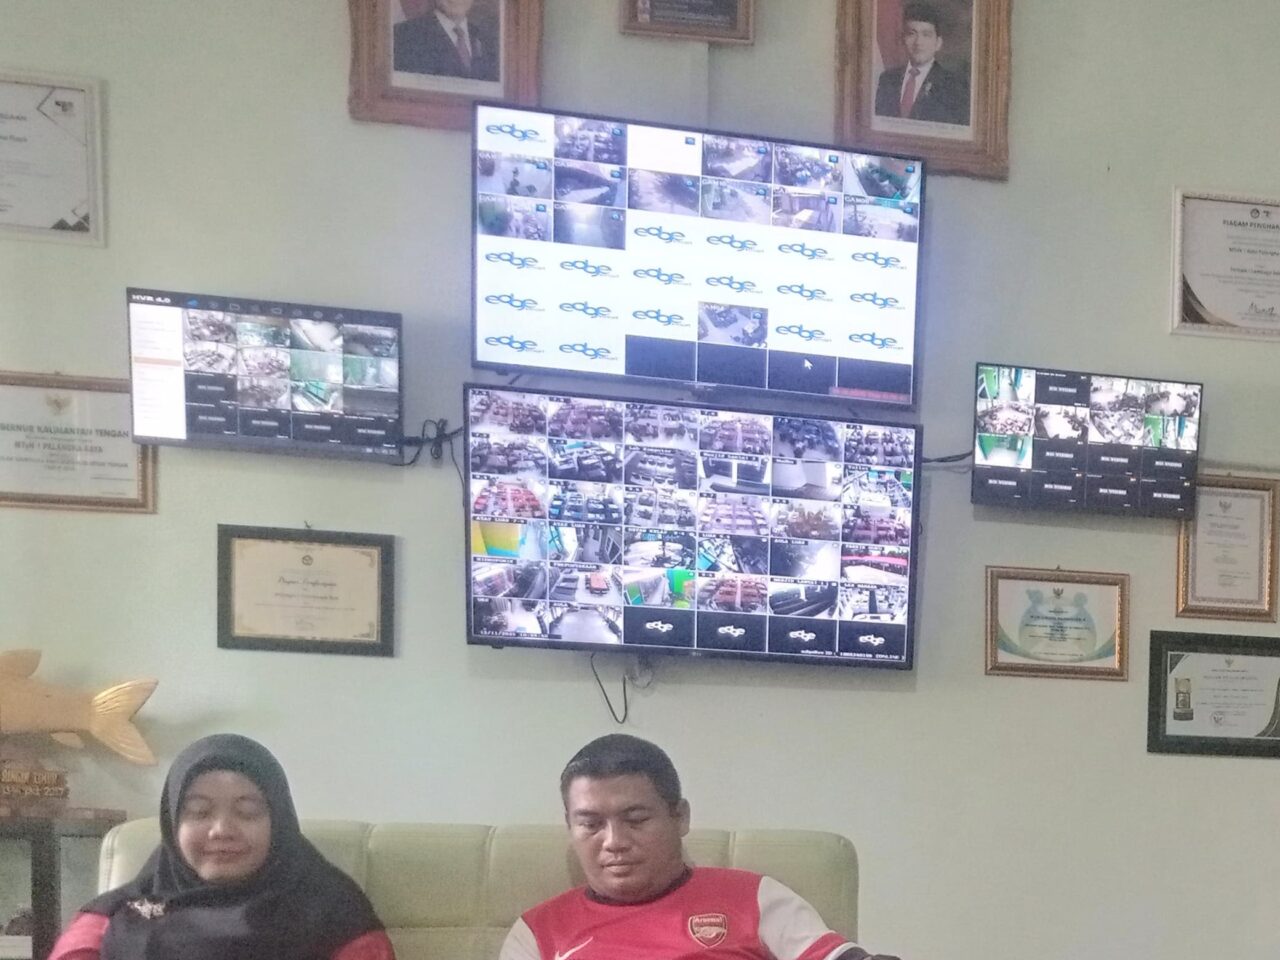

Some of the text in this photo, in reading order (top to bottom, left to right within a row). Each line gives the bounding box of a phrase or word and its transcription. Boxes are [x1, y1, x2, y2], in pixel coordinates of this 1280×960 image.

[486, 123, 540, 141] edge
[634, 225, 685, 244] edge
[706, 234, 757, 252] edge
[778, 242, 828, 260] edge
[851, 251, 901, 269] edge
[485, 251, 538, 270] edge
[560, 259, 612, 277] edge
[633, 267, 685, 285] edge
[705, 275, 756, 293] edge
[777, 284, 827, 301] edge
[850, 292, 899, 309] edge
[485, 293, 538, 311] edge
[559, 301, 611, 318] edge
[632, 309, 684, 326] edge
[775, 324, 826, 342] edge
[848, 332, 898, 349] edge
[484, 335, 537, 353] edge
[559, 342, 611, 360] edge
[693, 916, 724, 924] Arsenal
